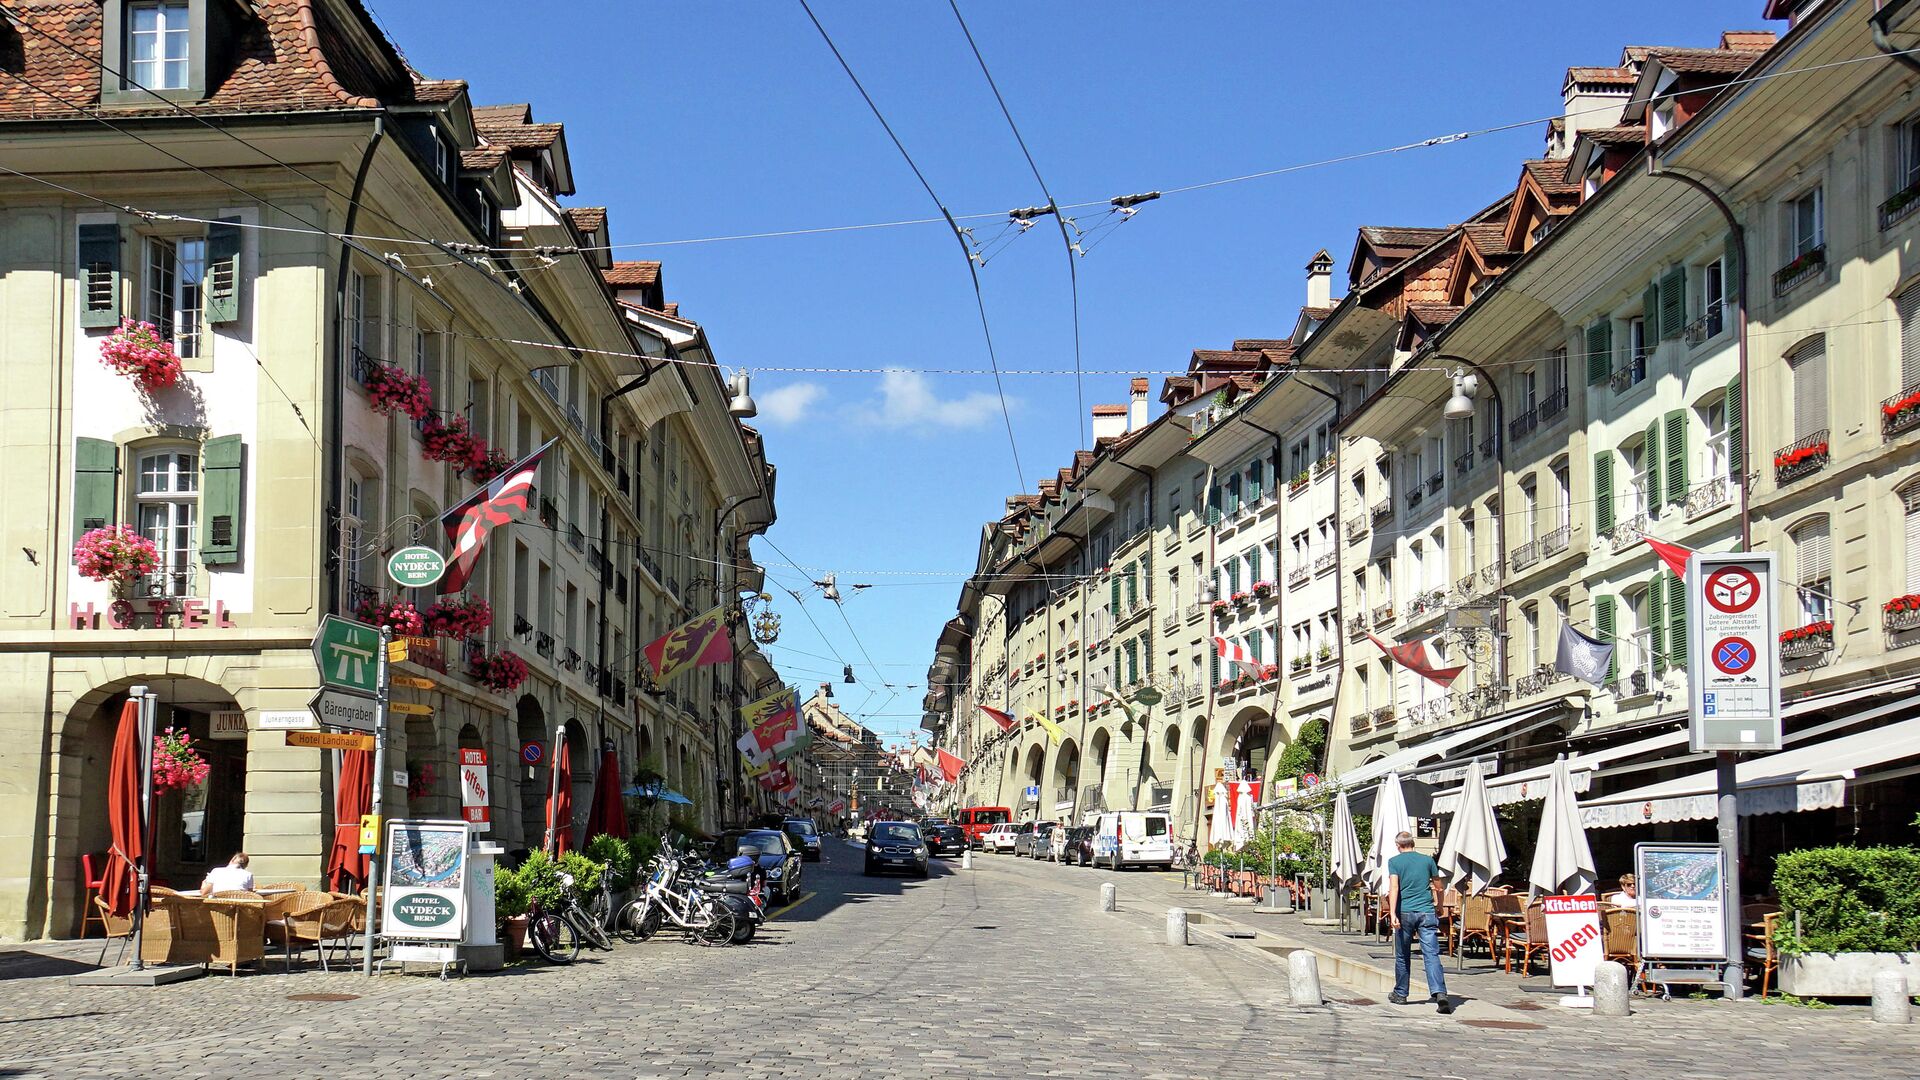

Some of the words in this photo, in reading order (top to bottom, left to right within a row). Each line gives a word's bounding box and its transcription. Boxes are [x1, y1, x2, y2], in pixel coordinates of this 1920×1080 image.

[394, 562, 440, 572] NYDECK
[70, 599, 236, 630] HOTEL
[324, 700, 374, 722] Bärengraben
[1707, 706, 1713, 714] P
[299, 736, 321, 744] Hotel
[323, 736, 359, 747] Landhaus
[464, 752, 483, 764] HOTEL
[470, 808, 483, 821] BAR
[399, 905, 451, 916] NYDECK
[1545, 898, 1596, 912] Kitchen
[413, 914, 437, 922] BERN
[1551, 923, 1598, 963] open
